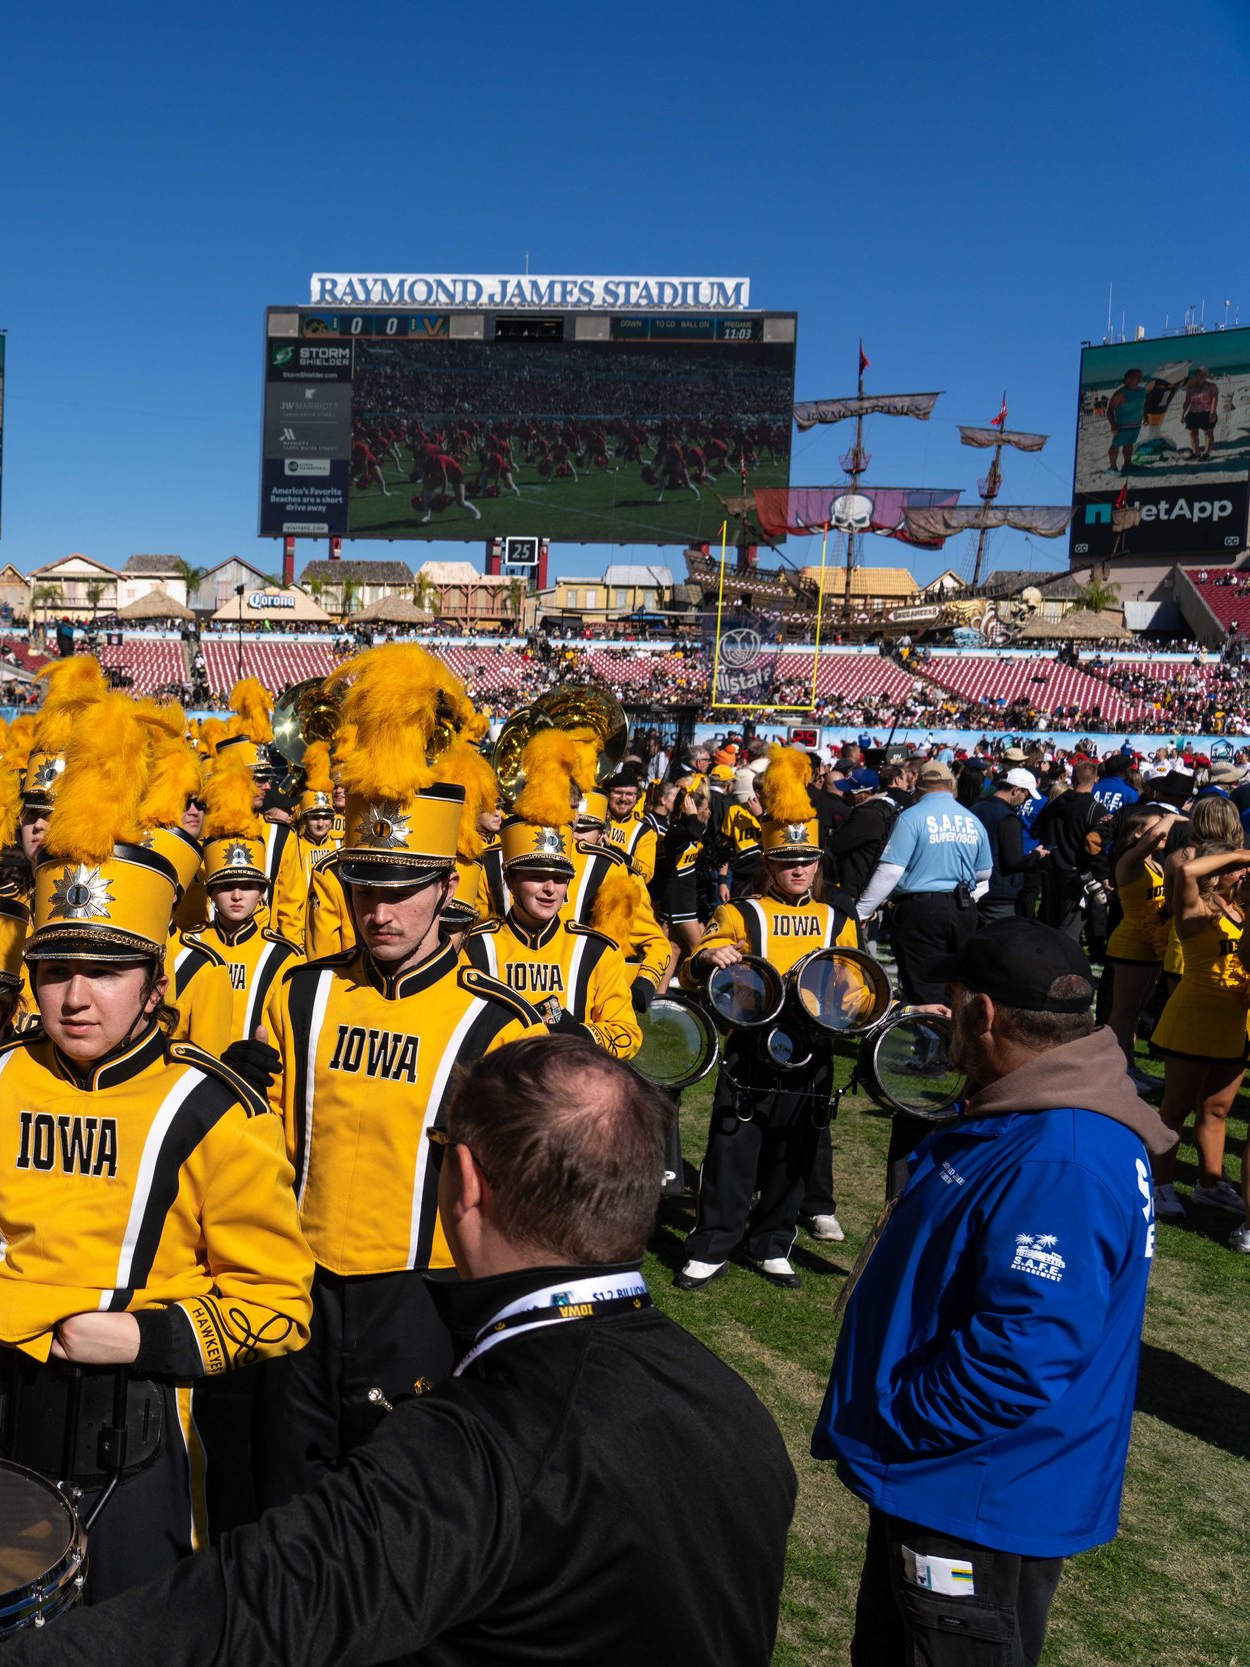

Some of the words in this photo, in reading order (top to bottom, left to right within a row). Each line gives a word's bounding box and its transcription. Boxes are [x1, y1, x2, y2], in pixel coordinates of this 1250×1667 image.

[317, 277, 484, 306] RAYMOND
[487, 278, 595, 307] JAMES
[602, 279, 746, 308] STADIUM
[351, 317, 362, 335] 0
[386, 317, 398, 335] 0
[620, 320, 643, 328] DOWN
[656, 320, 664, 328] TO
[681, 320, 697, 328] BALL
[699, 321, 710, 329] ON
[724, 329, 752, 339] 11:03
[300, 347, 349, 358] STORM
[300, 358, 349, 366] SHIELDER
[280, 402, 295, 410] JW
[295, 402, 338, 410] MARRIOTT
[272, 487, 309, 495] America's
[310, 487, 342, 495] Favorite
[270, 495, 301, 503] Beaches
[321, 495, 343, 504] short
[286, 503, 306, 511] drive
[307, 505, 327, 513] away
[512, 543, 531, 559] 25
[249, 592, 296, 609] Corona
[926, 814, 978, 834] S.A.F.E.
[929, 832, 979, 846] SUPERVISOR
[772, 915, 822, 938] IOWA
[505, 962, 565, 992] IOWA
[328, 1023, 421, 1084] IOWA
[16, 1110, 119, 1179] IOWA
[1010, 1263, 1063, 1282] MANAGEMENT
[1012, 1256, 1063, 1277] S.A.F.E.
[558, 1303, 594, 1318] IOWA
[192, 1306, 224, 1375] HAWKEYES
